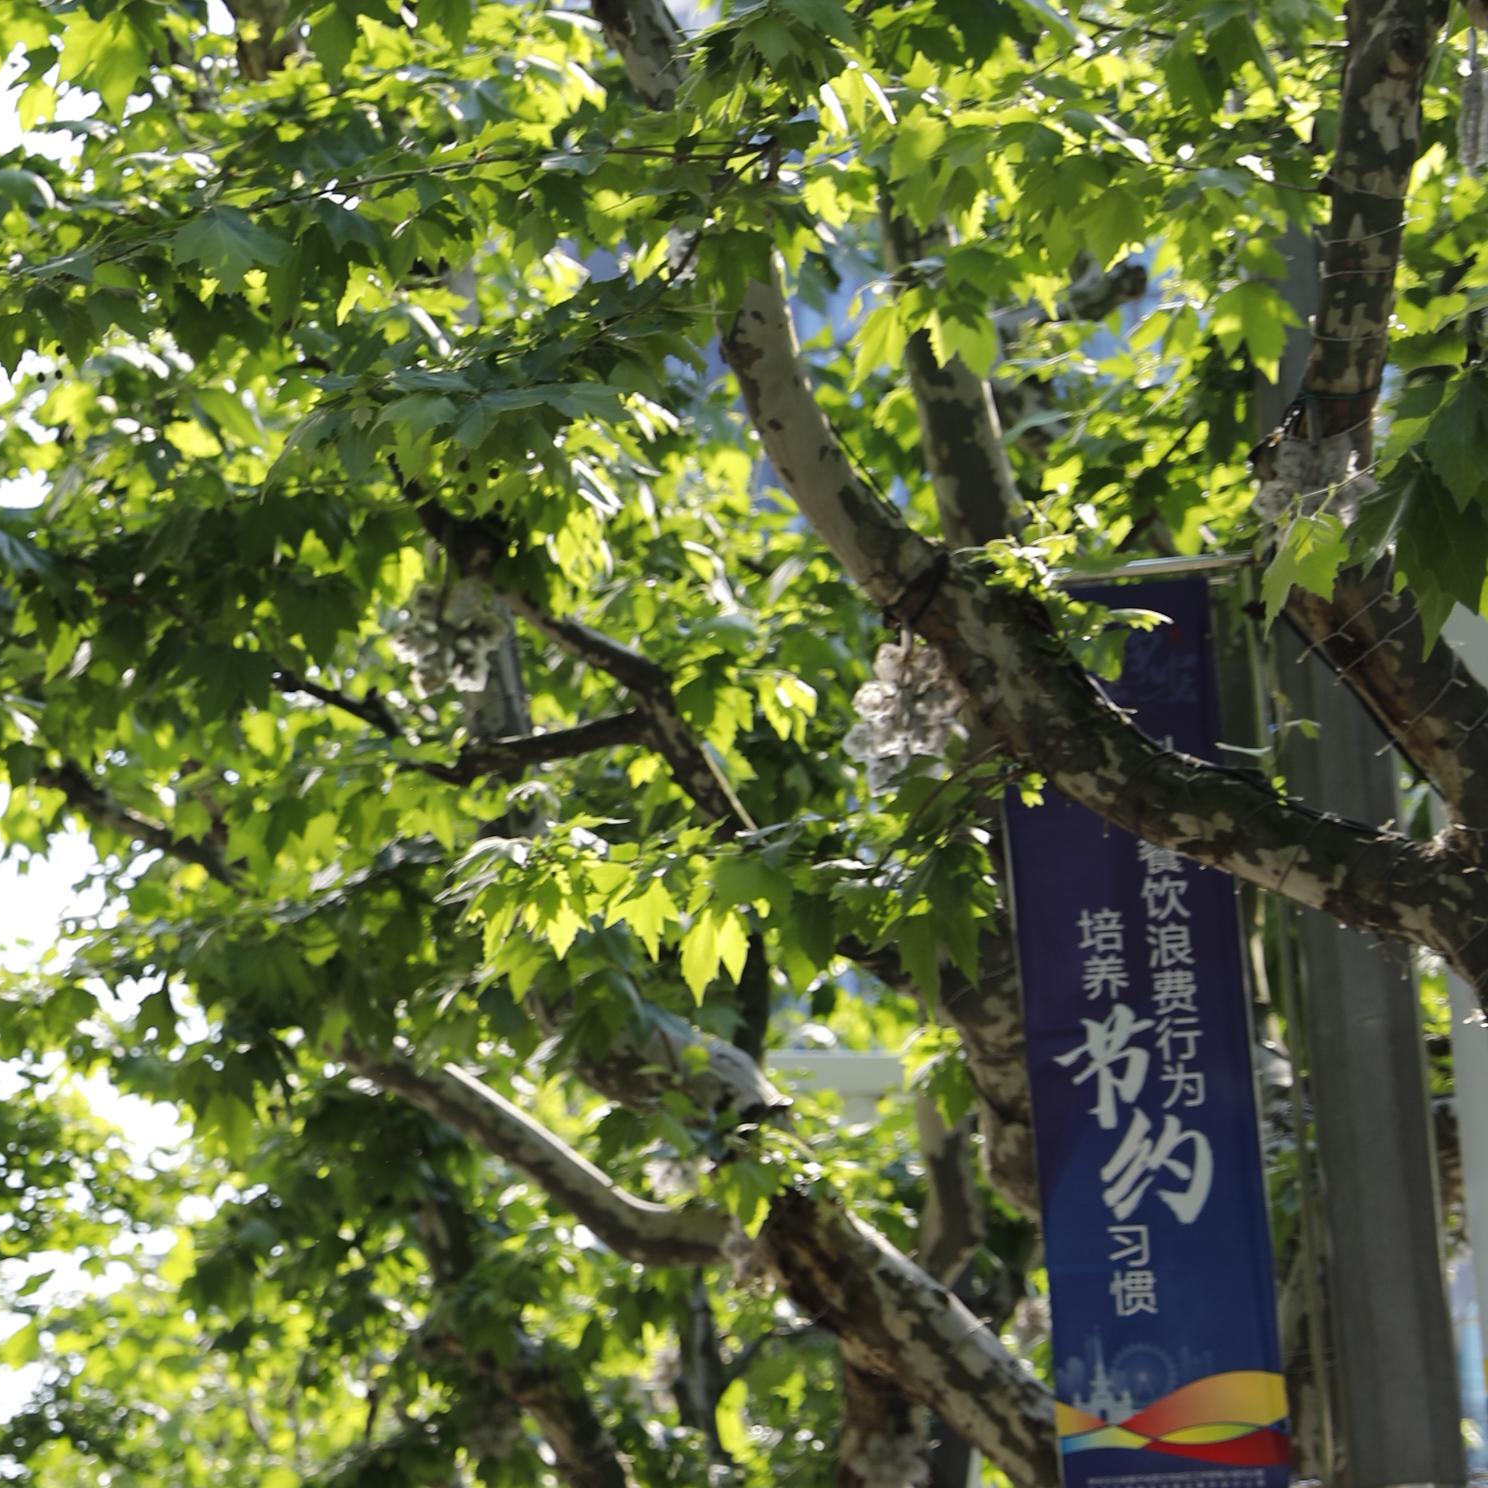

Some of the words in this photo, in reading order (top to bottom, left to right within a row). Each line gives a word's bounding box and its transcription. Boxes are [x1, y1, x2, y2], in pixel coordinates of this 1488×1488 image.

[1136, 734, 1207, 1108] 餐饮浪费行为
